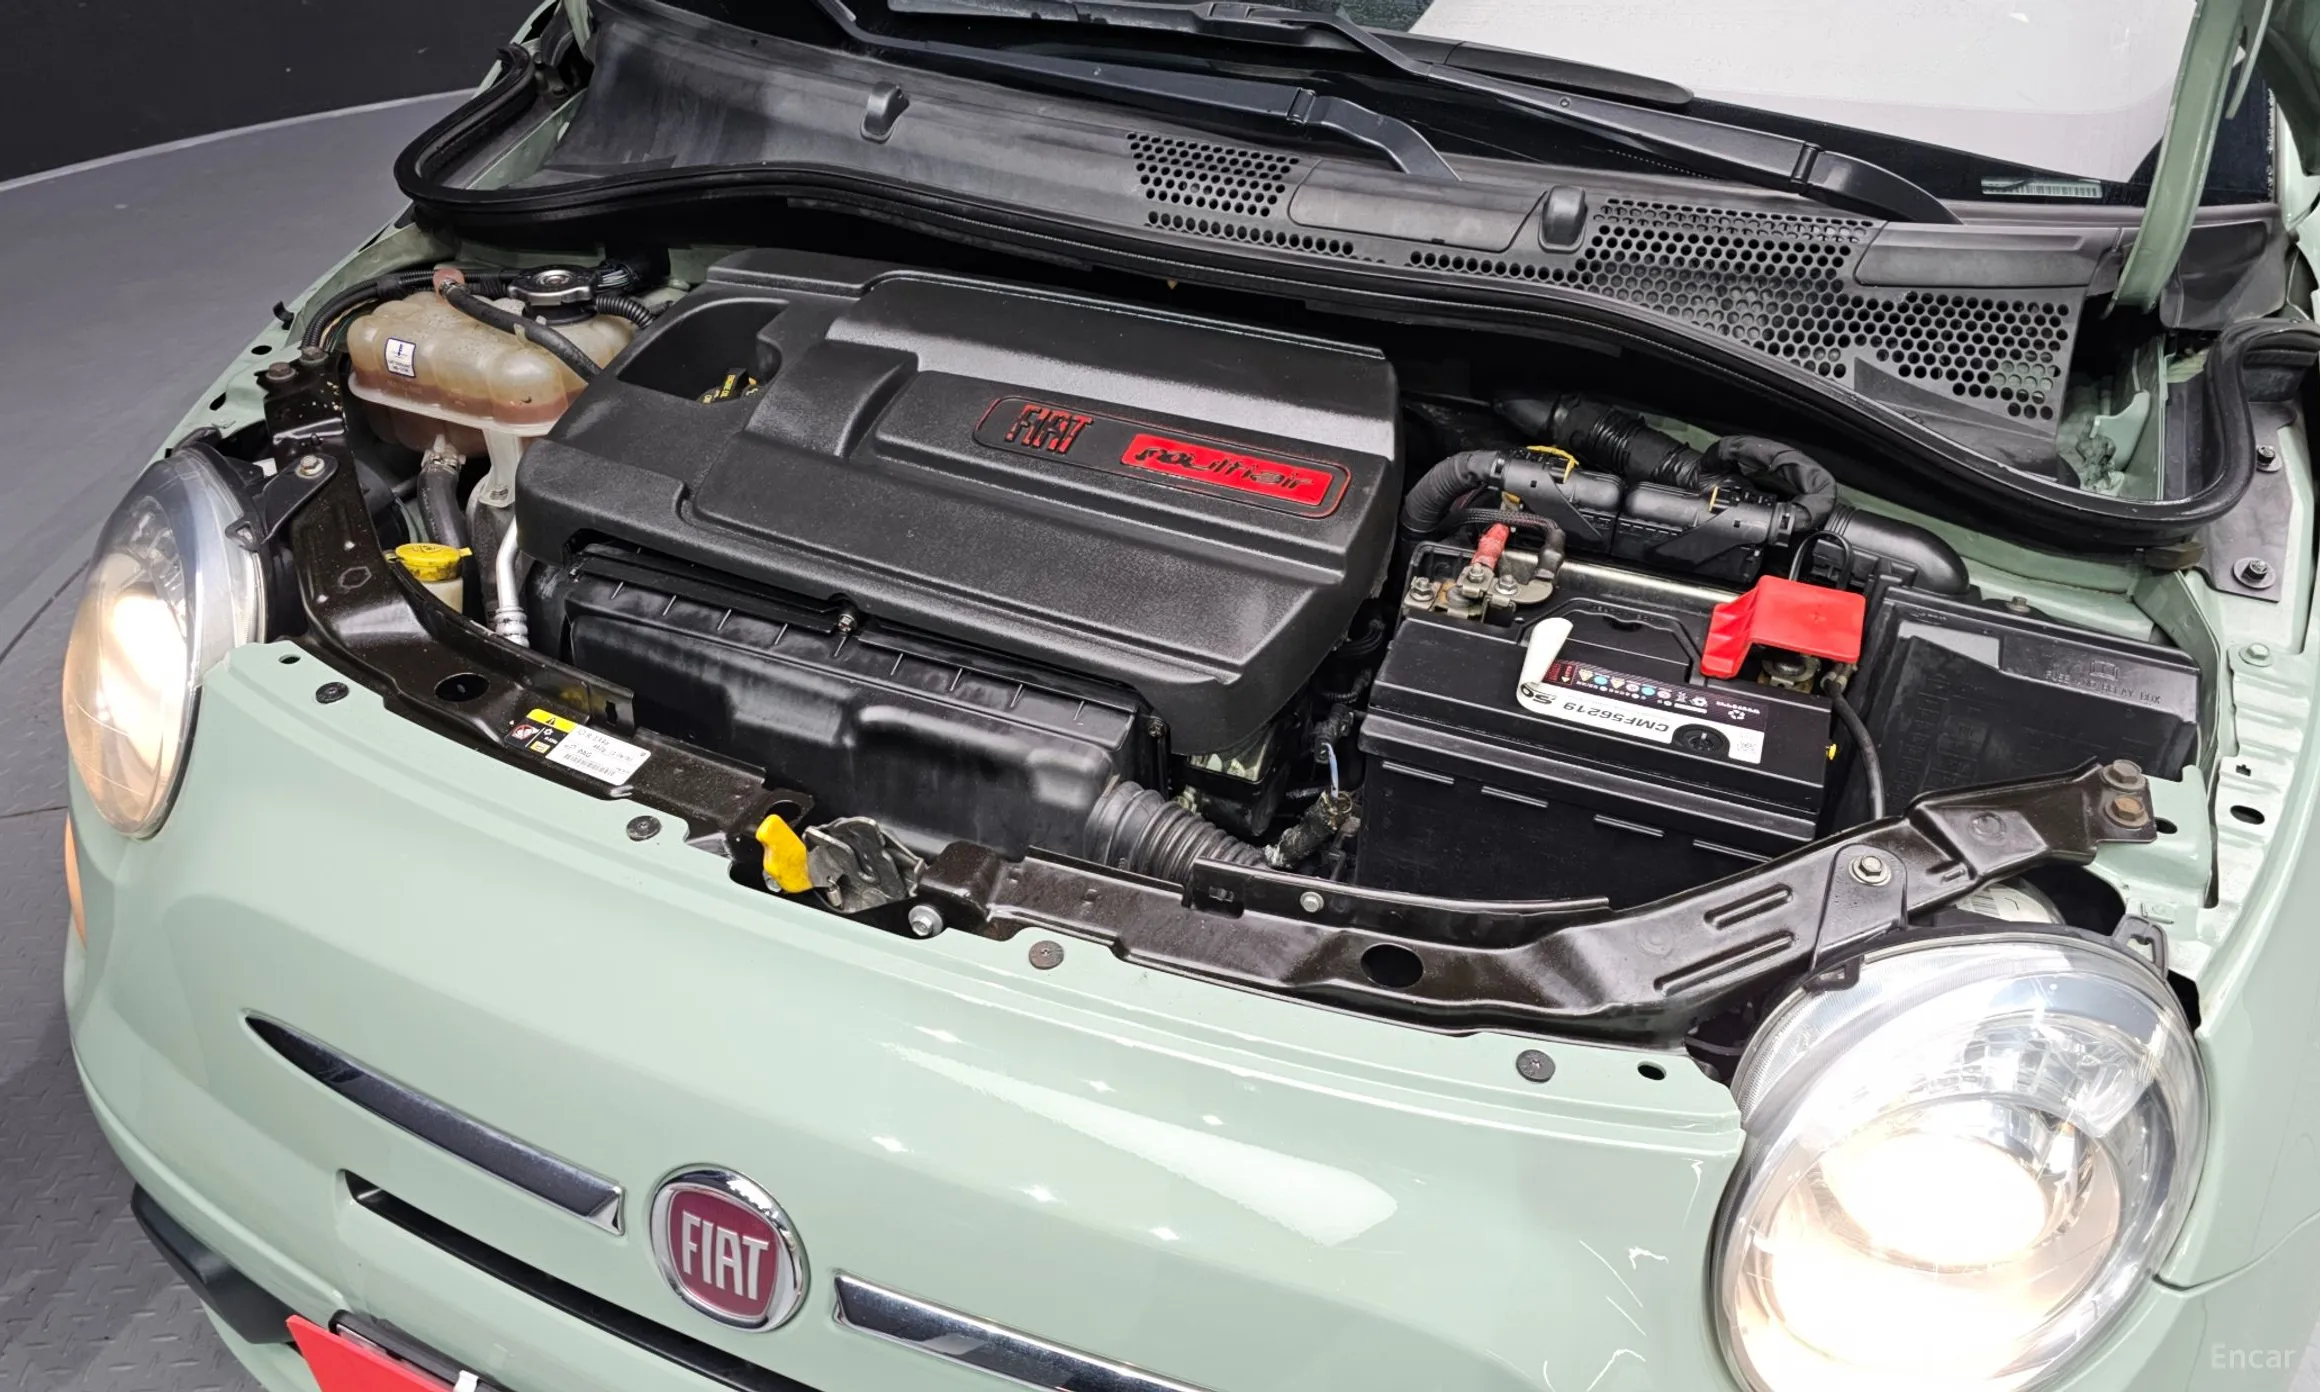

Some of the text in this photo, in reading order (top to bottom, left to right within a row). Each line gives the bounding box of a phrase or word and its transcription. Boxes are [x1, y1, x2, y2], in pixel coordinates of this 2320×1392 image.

[1005, 404, 1093, 454] FIAT
[1563, 702, 1670, 733] CMF56219
[682, 1210, 769, 1300] FIAT
